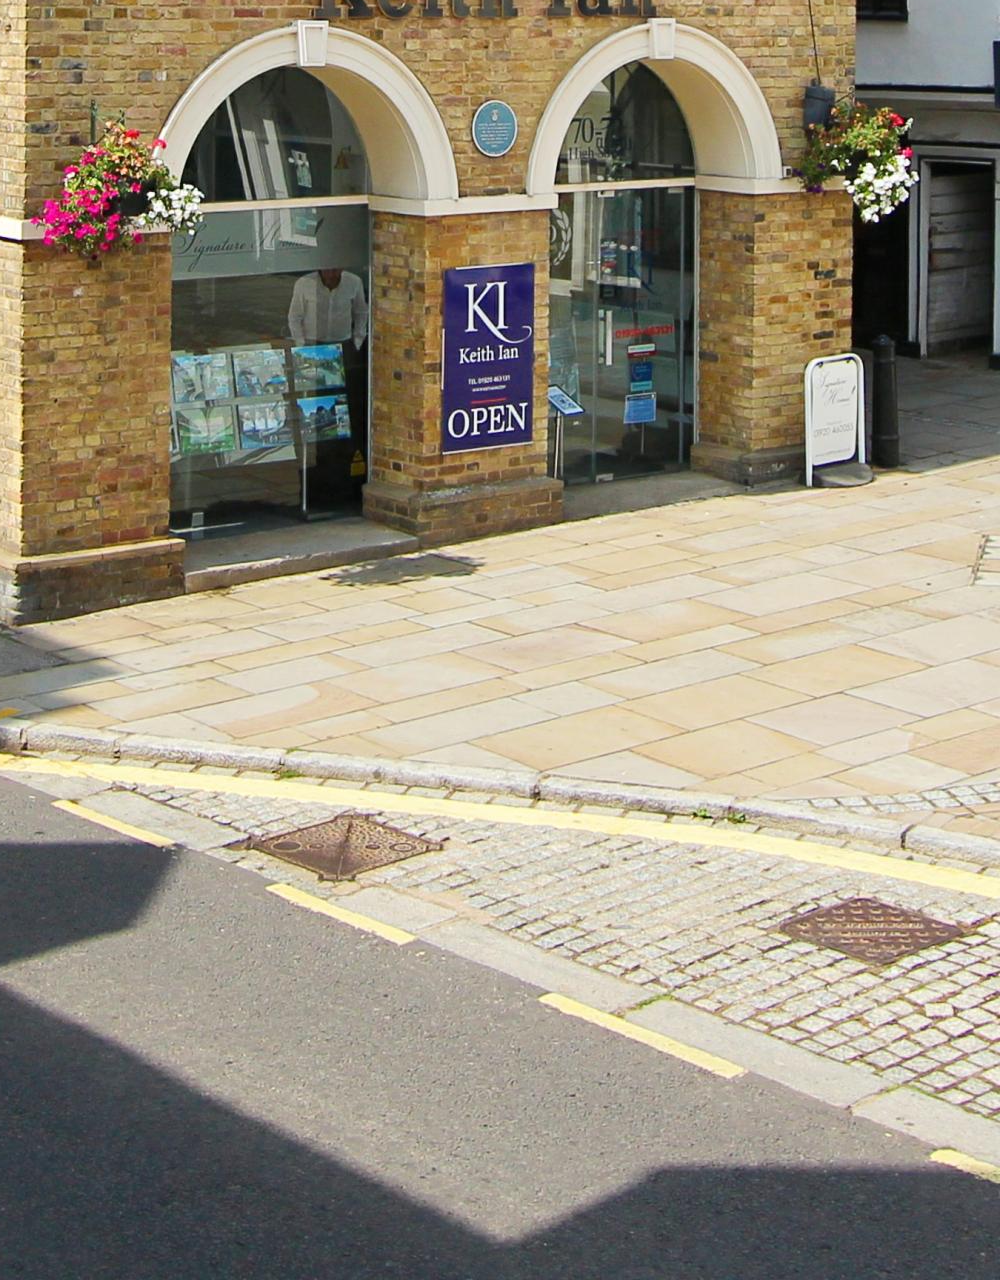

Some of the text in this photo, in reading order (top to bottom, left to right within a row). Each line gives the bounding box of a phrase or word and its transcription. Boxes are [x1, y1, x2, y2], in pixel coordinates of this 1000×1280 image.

[178, 222, 248, 273] Signature
[464, 281, 532, 344] KI
[459, 344, 520, 364] Keith Ian
[447, 402, 529, 439] OPEN
